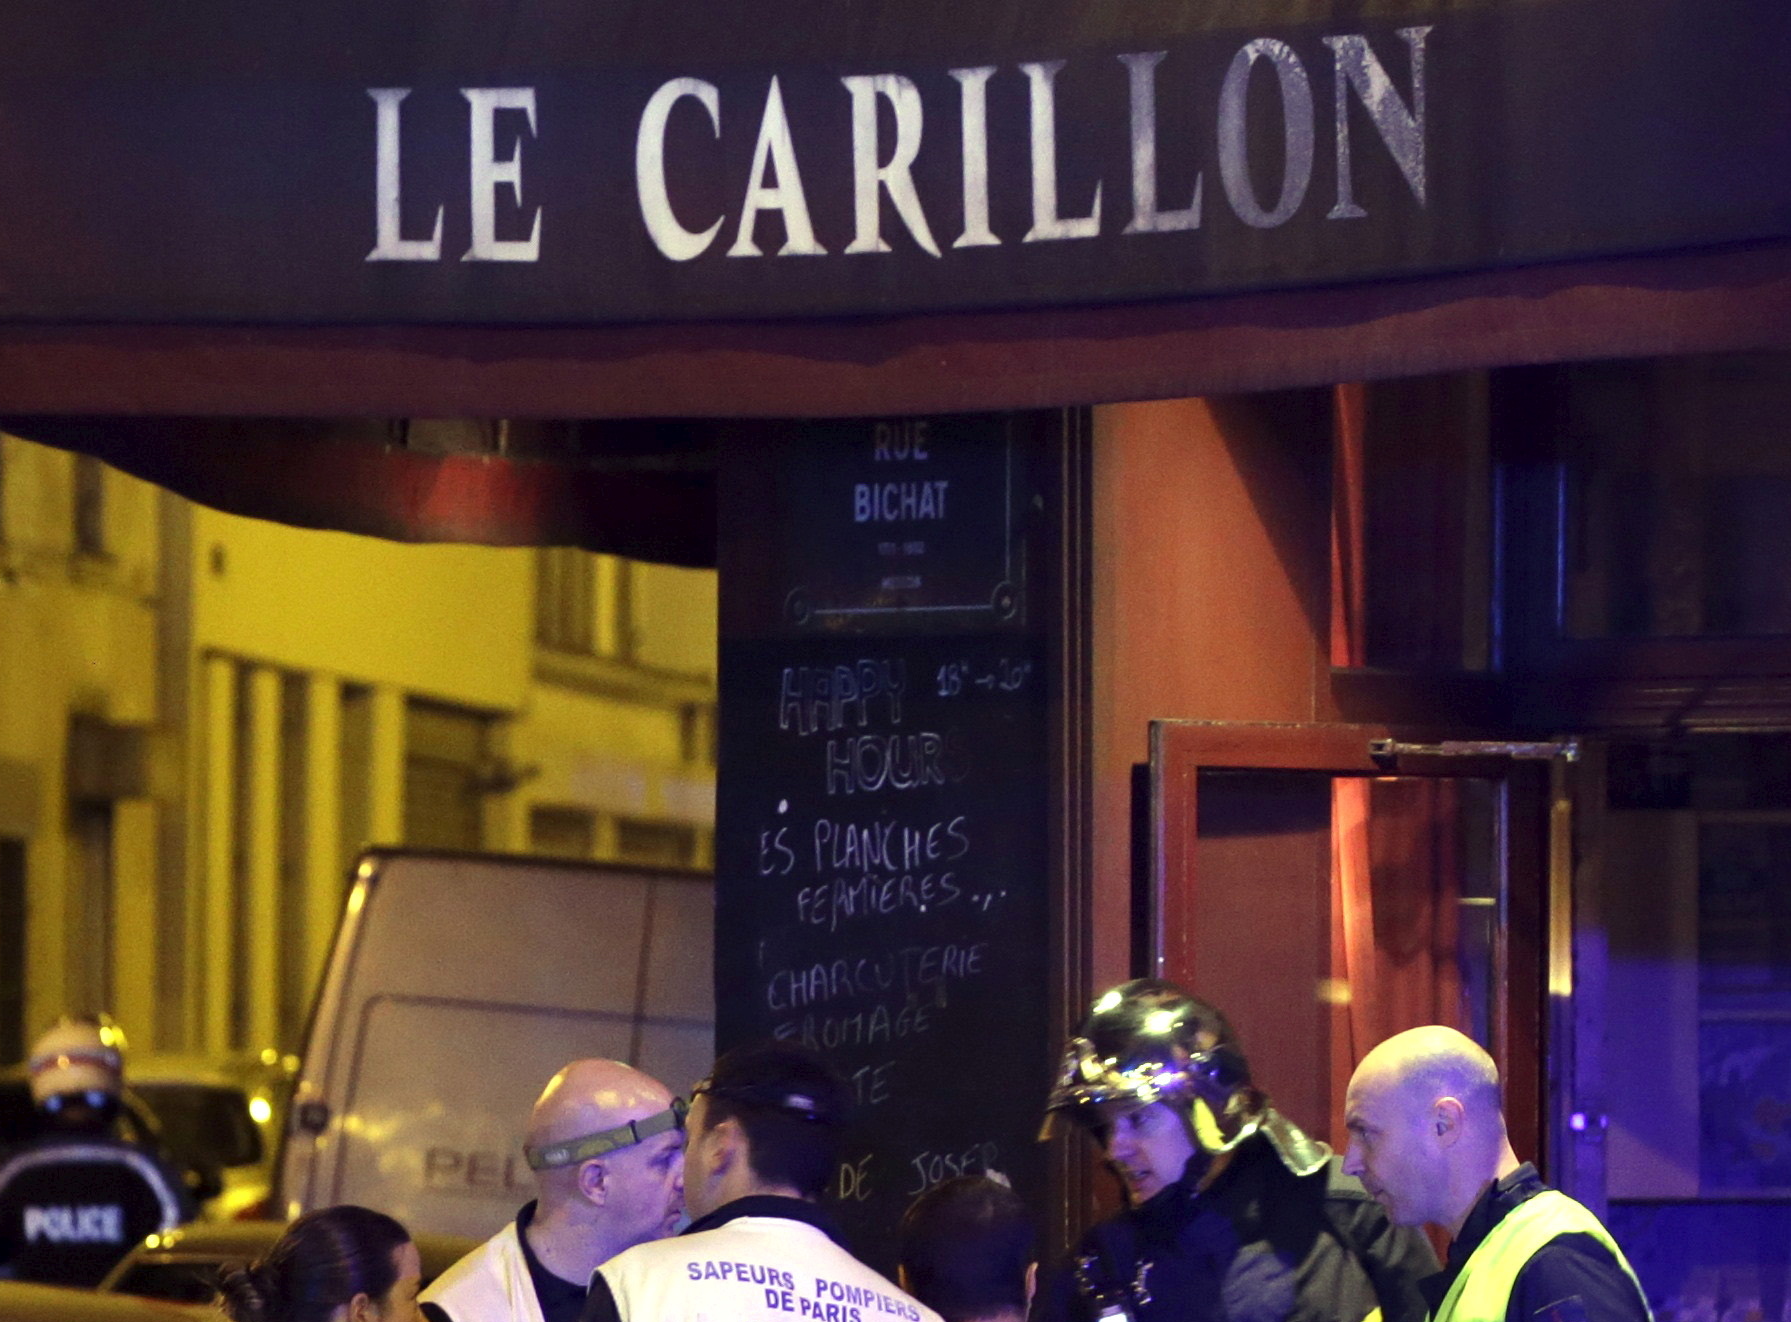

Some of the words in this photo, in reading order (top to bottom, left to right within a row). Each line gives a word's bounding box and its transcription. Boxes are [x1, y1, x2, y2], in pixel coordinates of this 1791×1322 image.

[364, 85, 542, 263] LE
[634, 25, 1435, 262] CARILLON
[873, 421, 930, 462] RUE
[853, 480, 950, 523] BICHAT
[778, 658, 906, 737] HAPPY
[814, 815, 971, 873] PLANCHES
[767, 942, 989, 1011] CHARCUTERIE
[838, 1153, 874, 1202] DE
[23, 1205, 123, 1243] POLICE
[687, 1259, 795, 1291] SAPEURS
[815, 1277, 921, 1322] POMPIERS
[765, 1288, 796, 1313] DE
